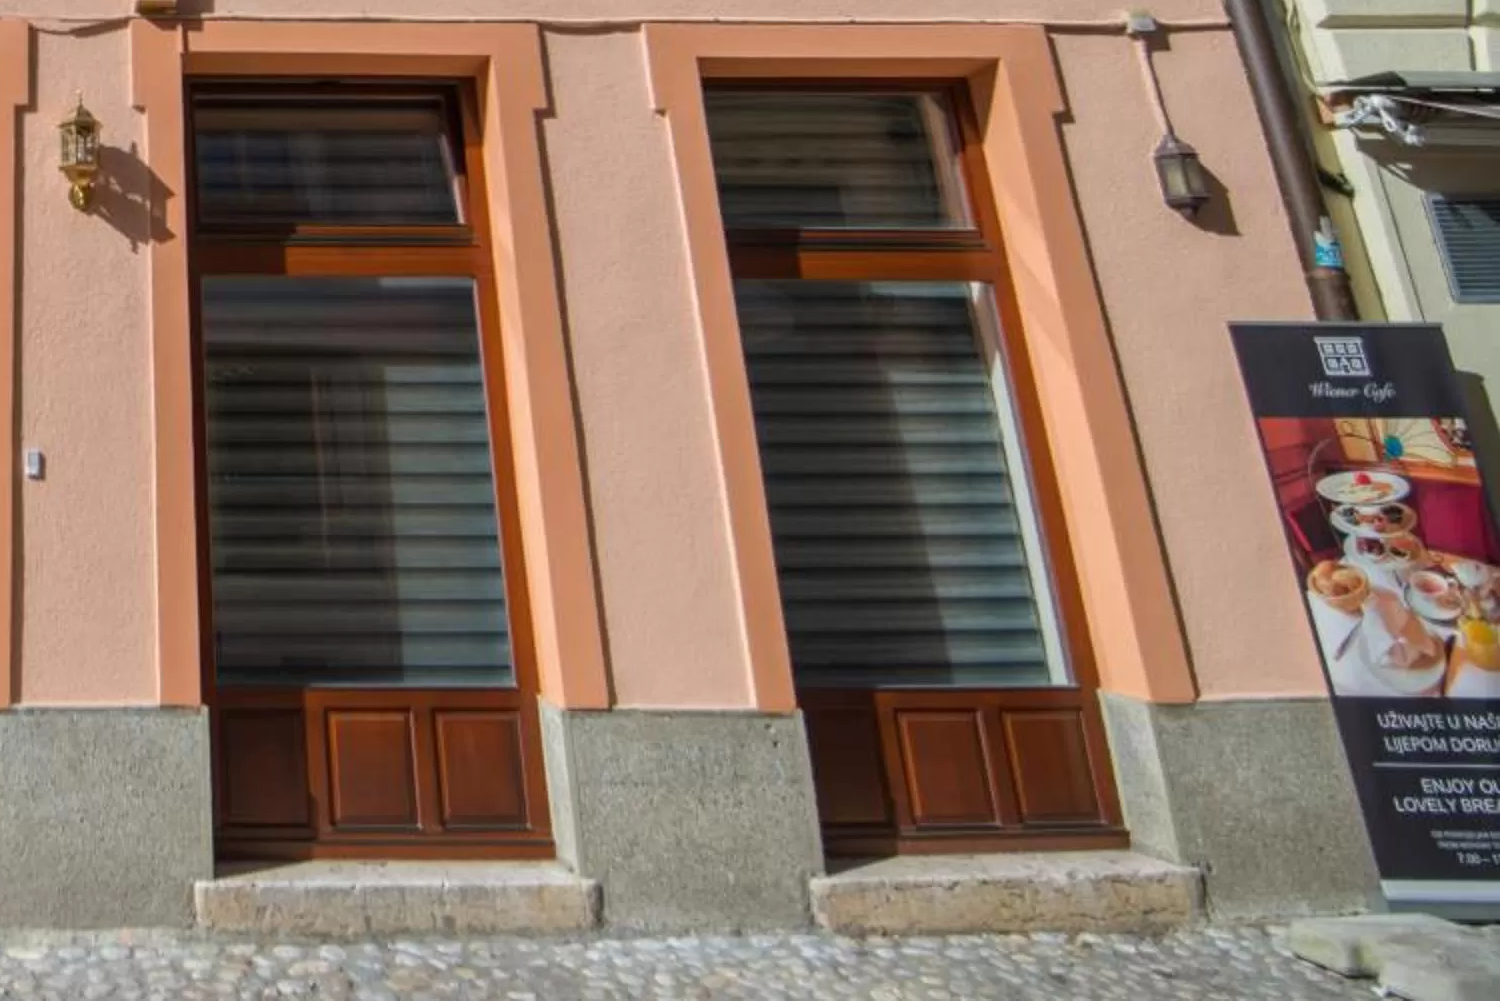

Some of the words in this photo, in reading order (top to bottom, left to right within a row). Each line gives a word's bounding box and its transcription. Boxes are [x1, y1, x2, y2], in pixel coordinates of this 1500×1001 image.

[1376, 711, 1445, 732] UŽIVAJTE
[1446, 714, 1461, 729] U
[1383, 735, 1449, 754] LIJEPOM
[1420, 778, 1474, 794] ENJOY
[1392, 796, 1457, 813] LOVELY
